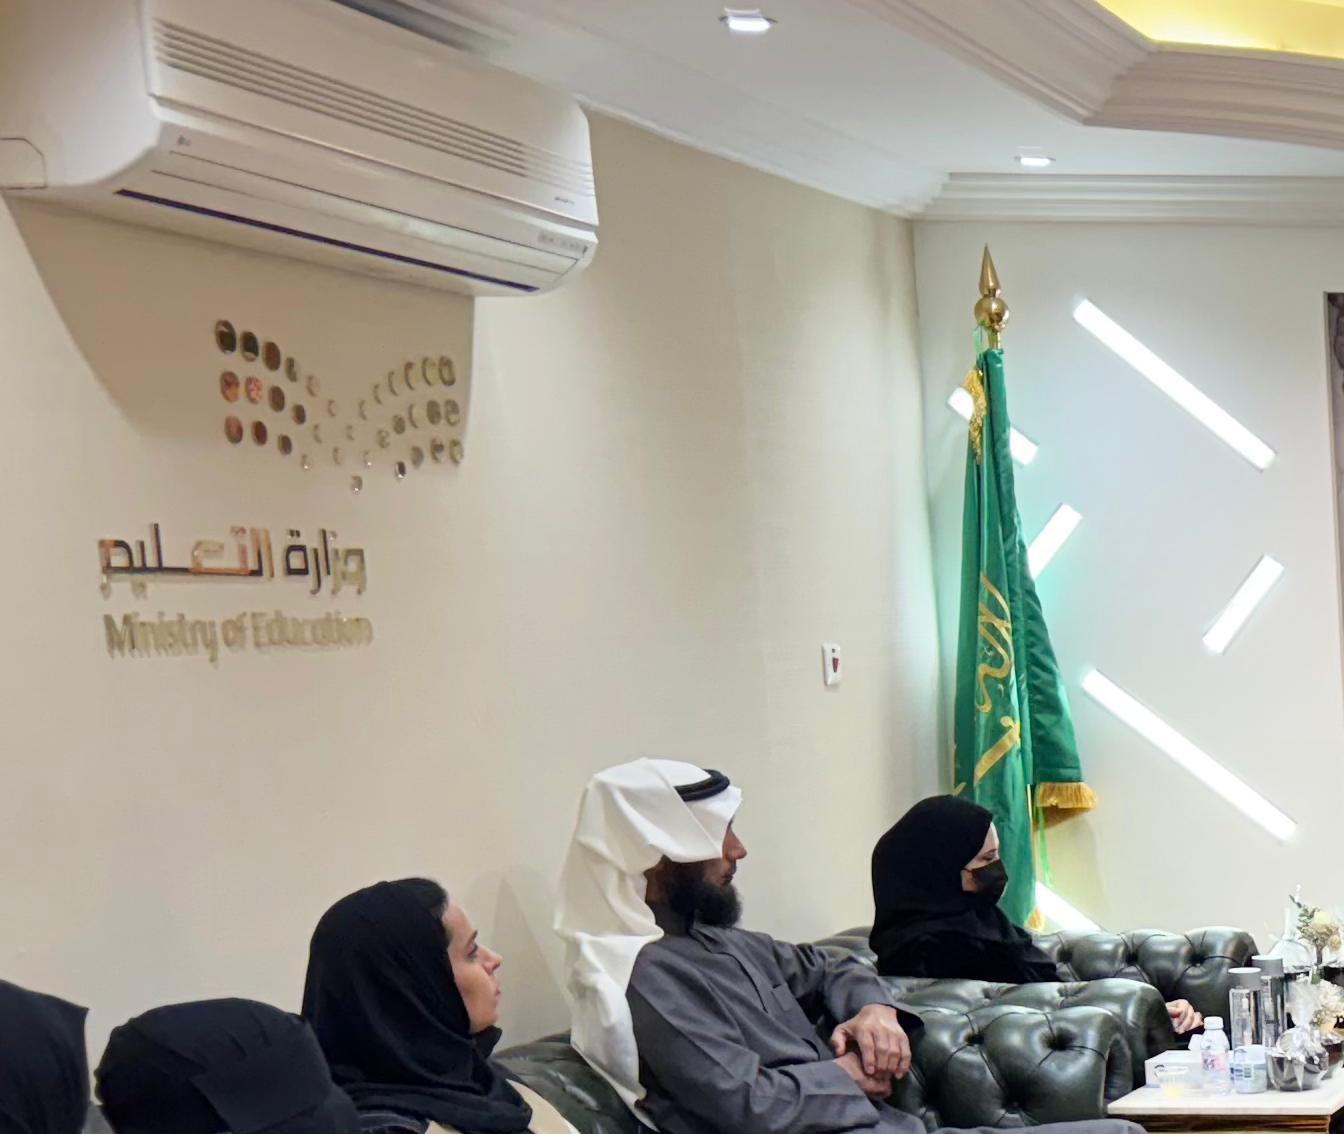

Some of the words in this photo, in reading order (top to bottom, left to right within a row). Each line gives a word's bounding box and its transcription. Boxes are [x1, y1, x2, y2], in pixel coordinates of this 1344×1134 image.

[98, 522, 274, 599] التعليم
[285, 527, 366, 596] وزارة
[103, 611, 218, 665] Ministry
[221, 612, 248, 649] of
[251, 610, 374, 650] Education
